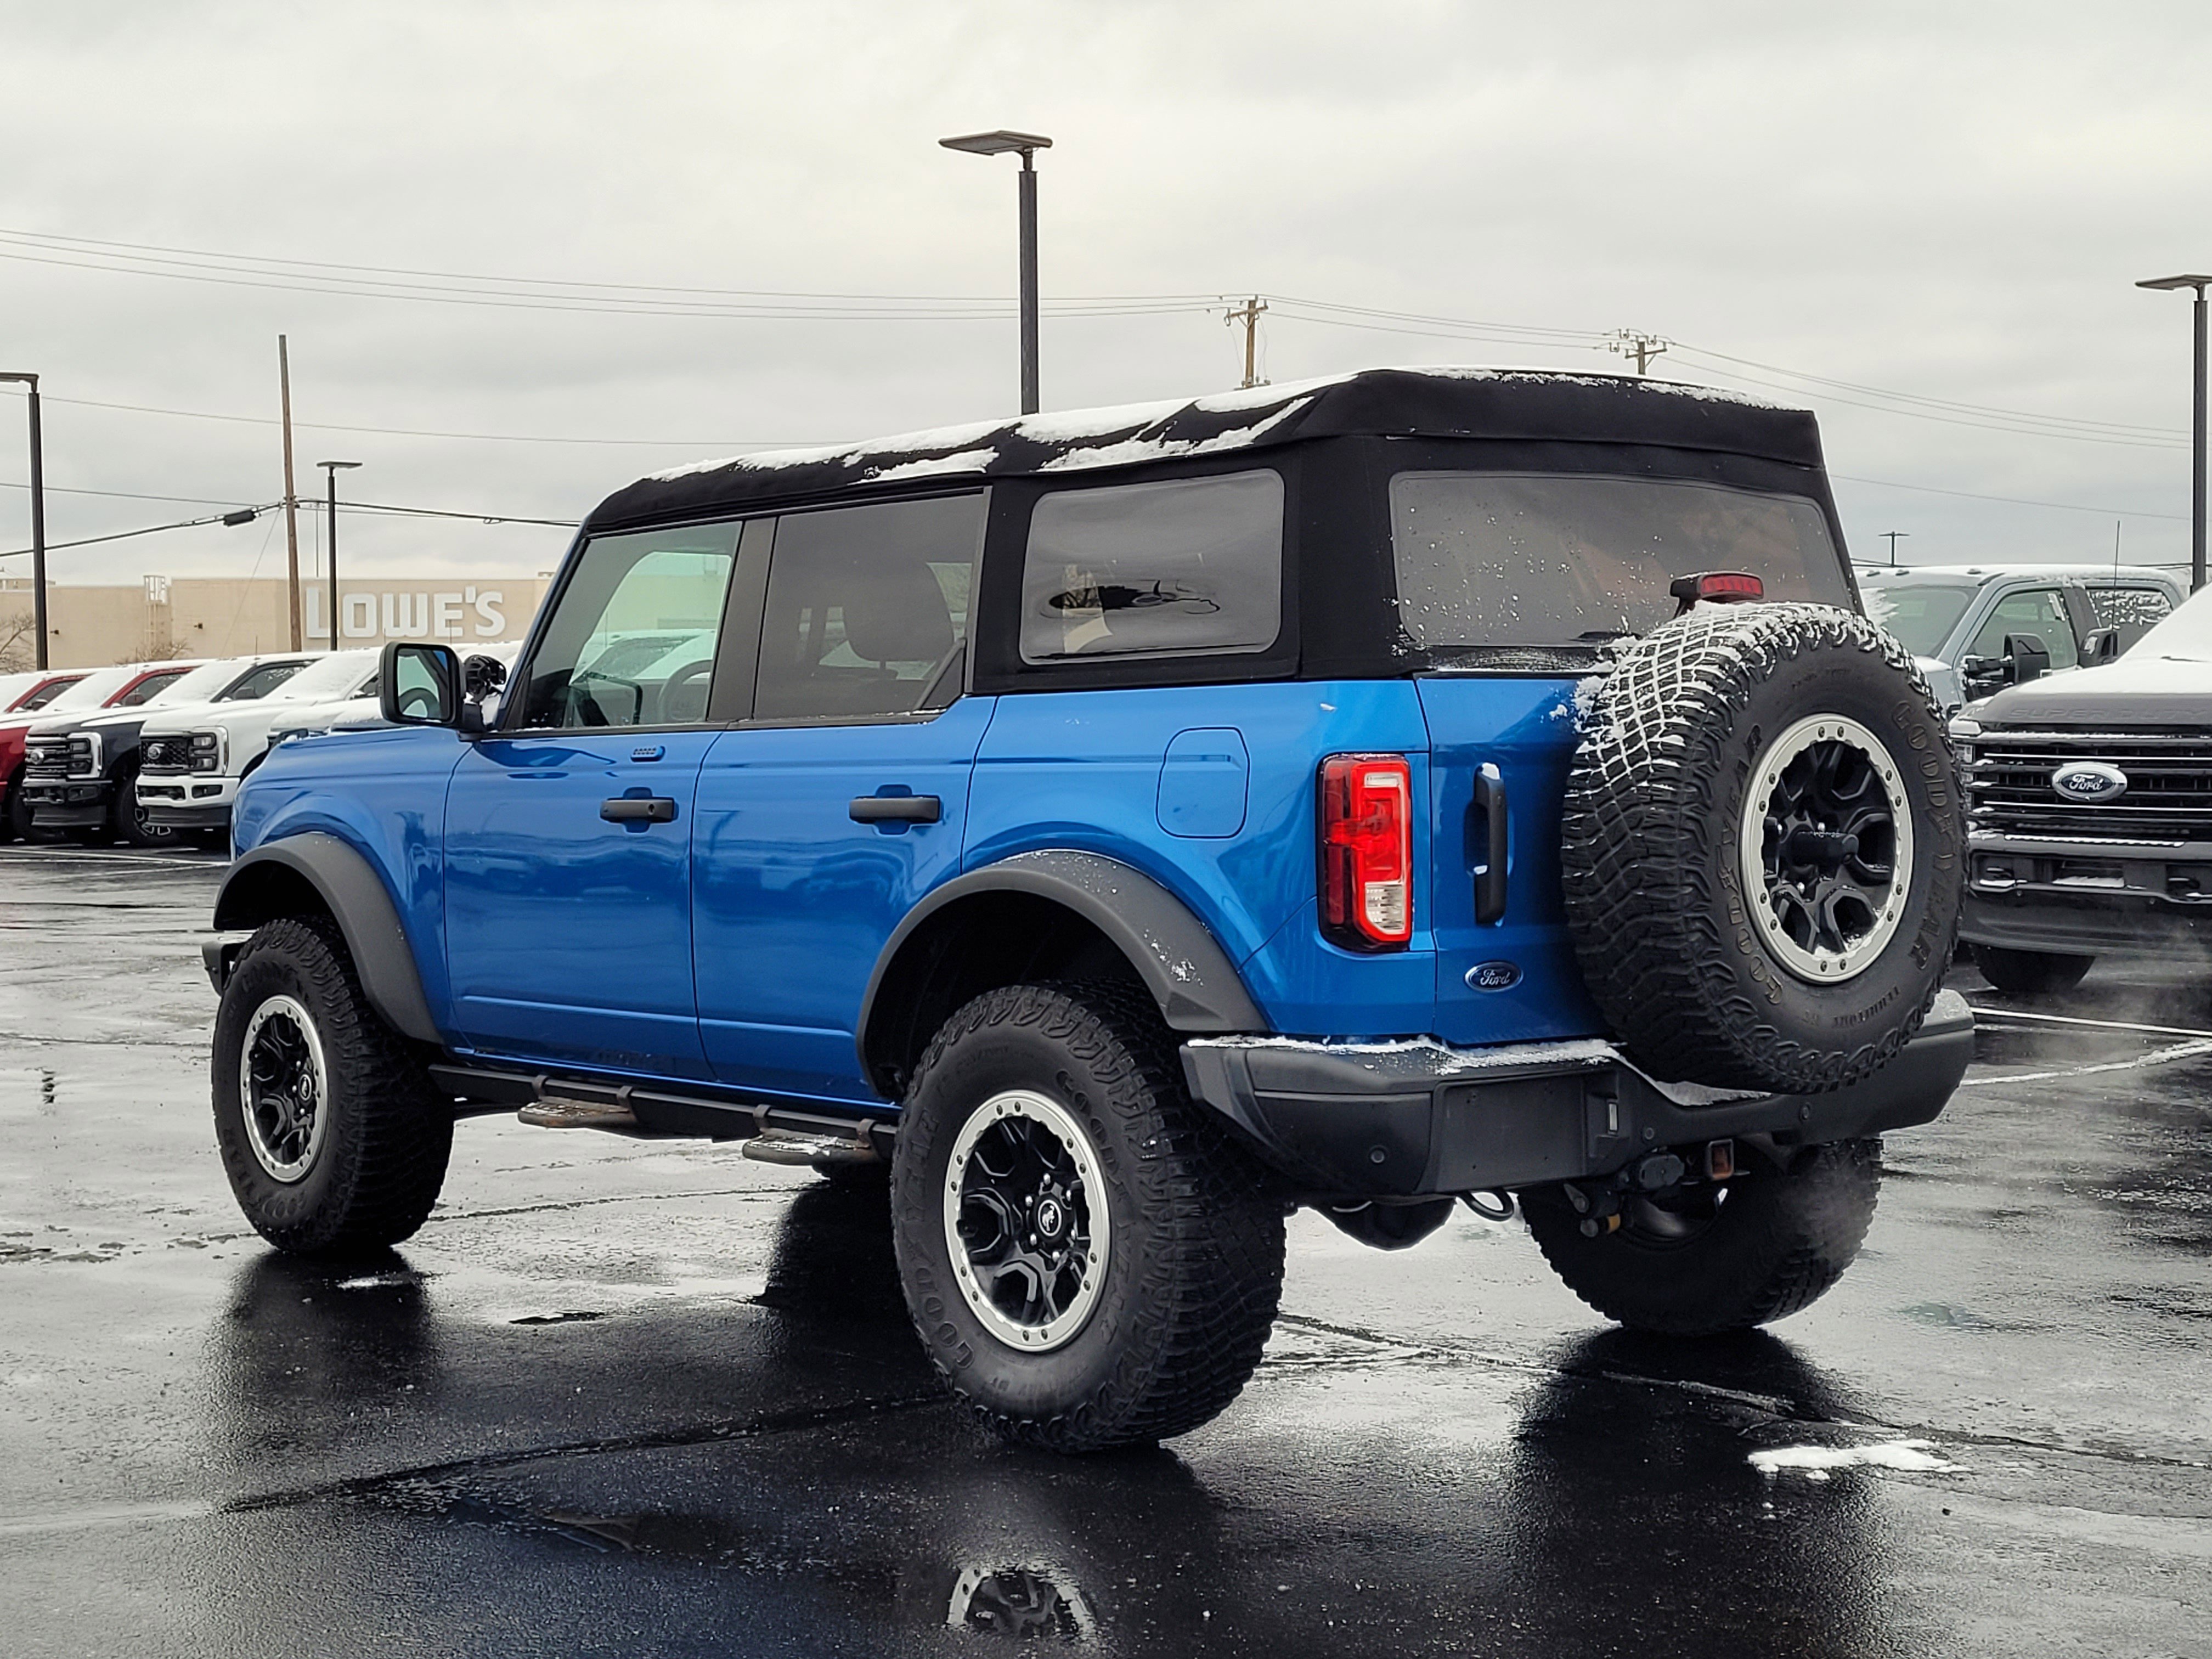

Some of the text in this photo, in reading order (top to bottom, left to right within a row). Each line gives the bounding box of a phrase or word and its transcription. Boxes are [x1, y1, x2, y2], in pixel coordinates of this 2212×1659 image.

[306, 586, 506, 638] LOWE'S
[2008, 708, 2208, 720] SUPER DUTY
[2068, 774, 2104, 791] Ford
[1480, 968, 1510, 985] Ford
